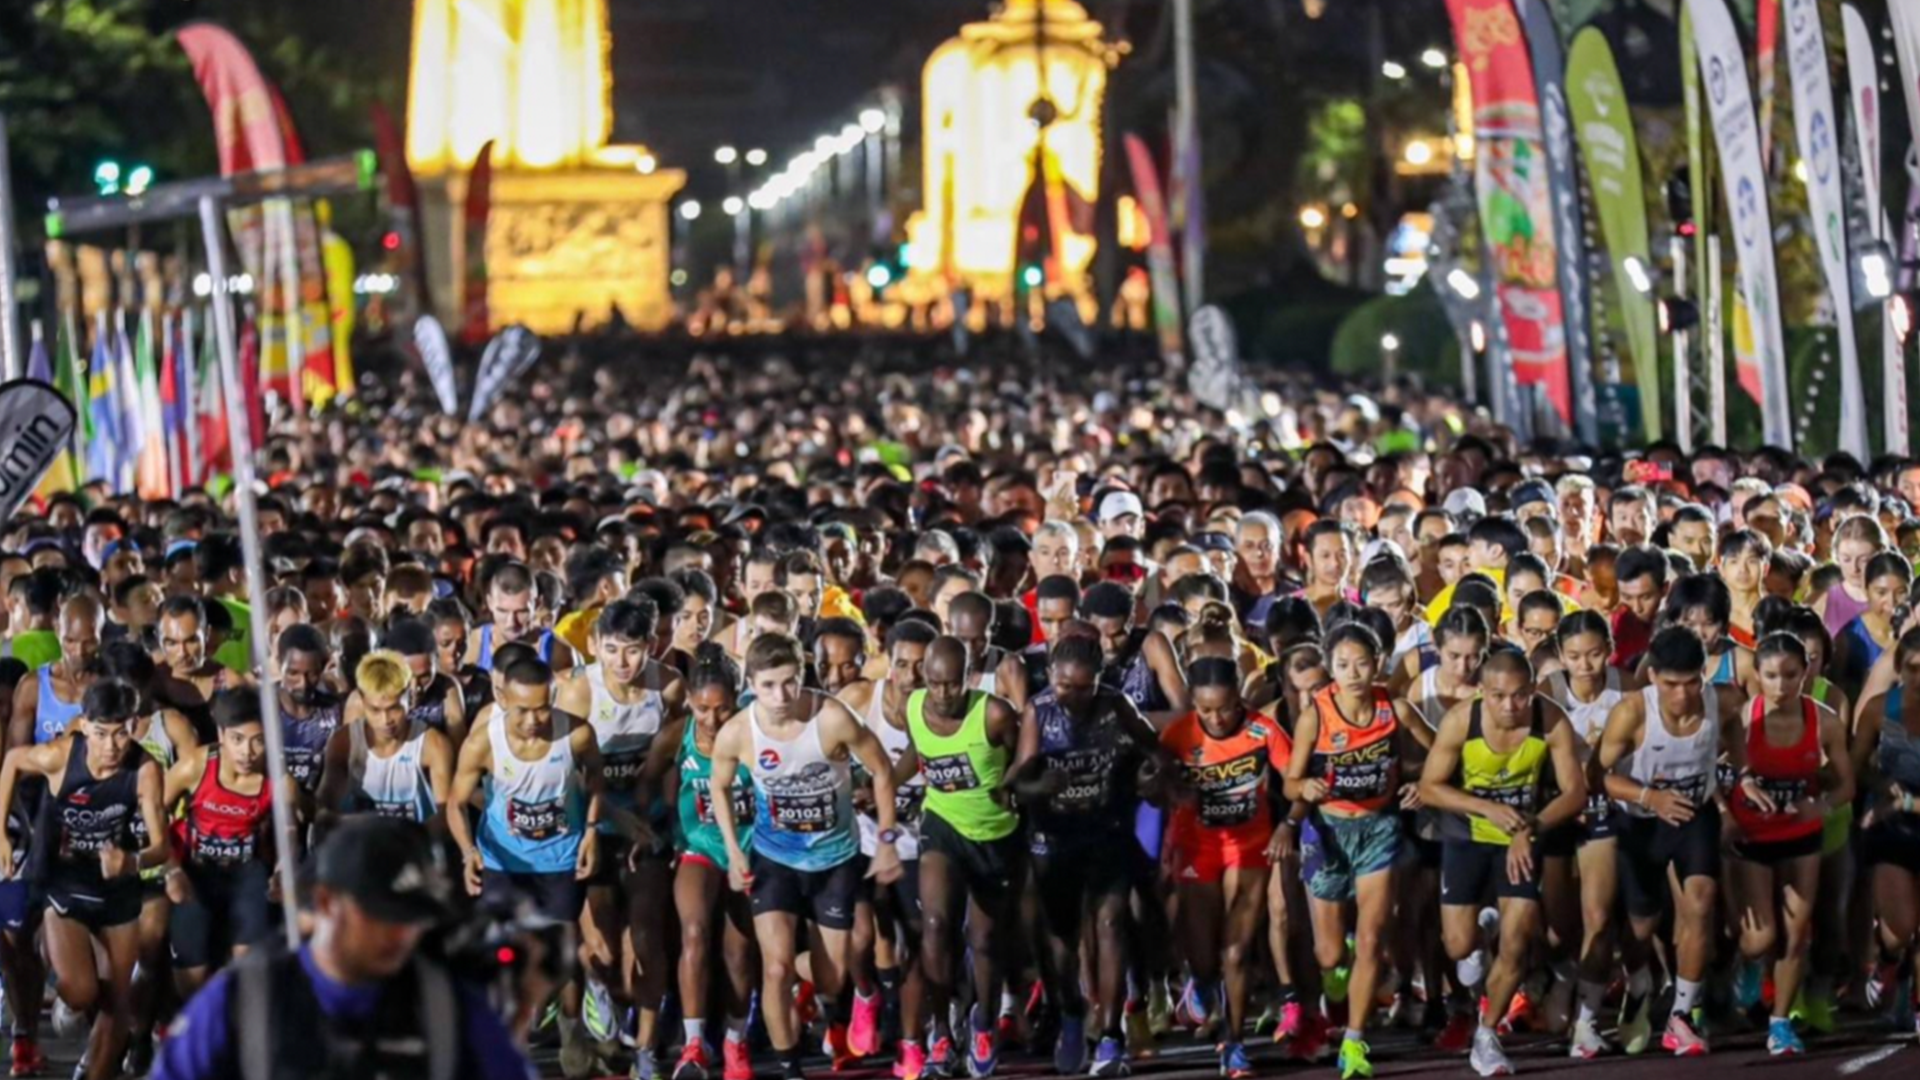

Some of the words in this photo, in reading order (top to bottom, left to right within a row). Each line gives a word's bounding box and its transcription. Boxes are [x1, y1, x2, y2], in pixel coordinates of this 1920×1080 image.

[777, 806, 823, 821] 20102
[1202, 802, 1246, 816] 20207
[513, 811, 555, 828] 20155
